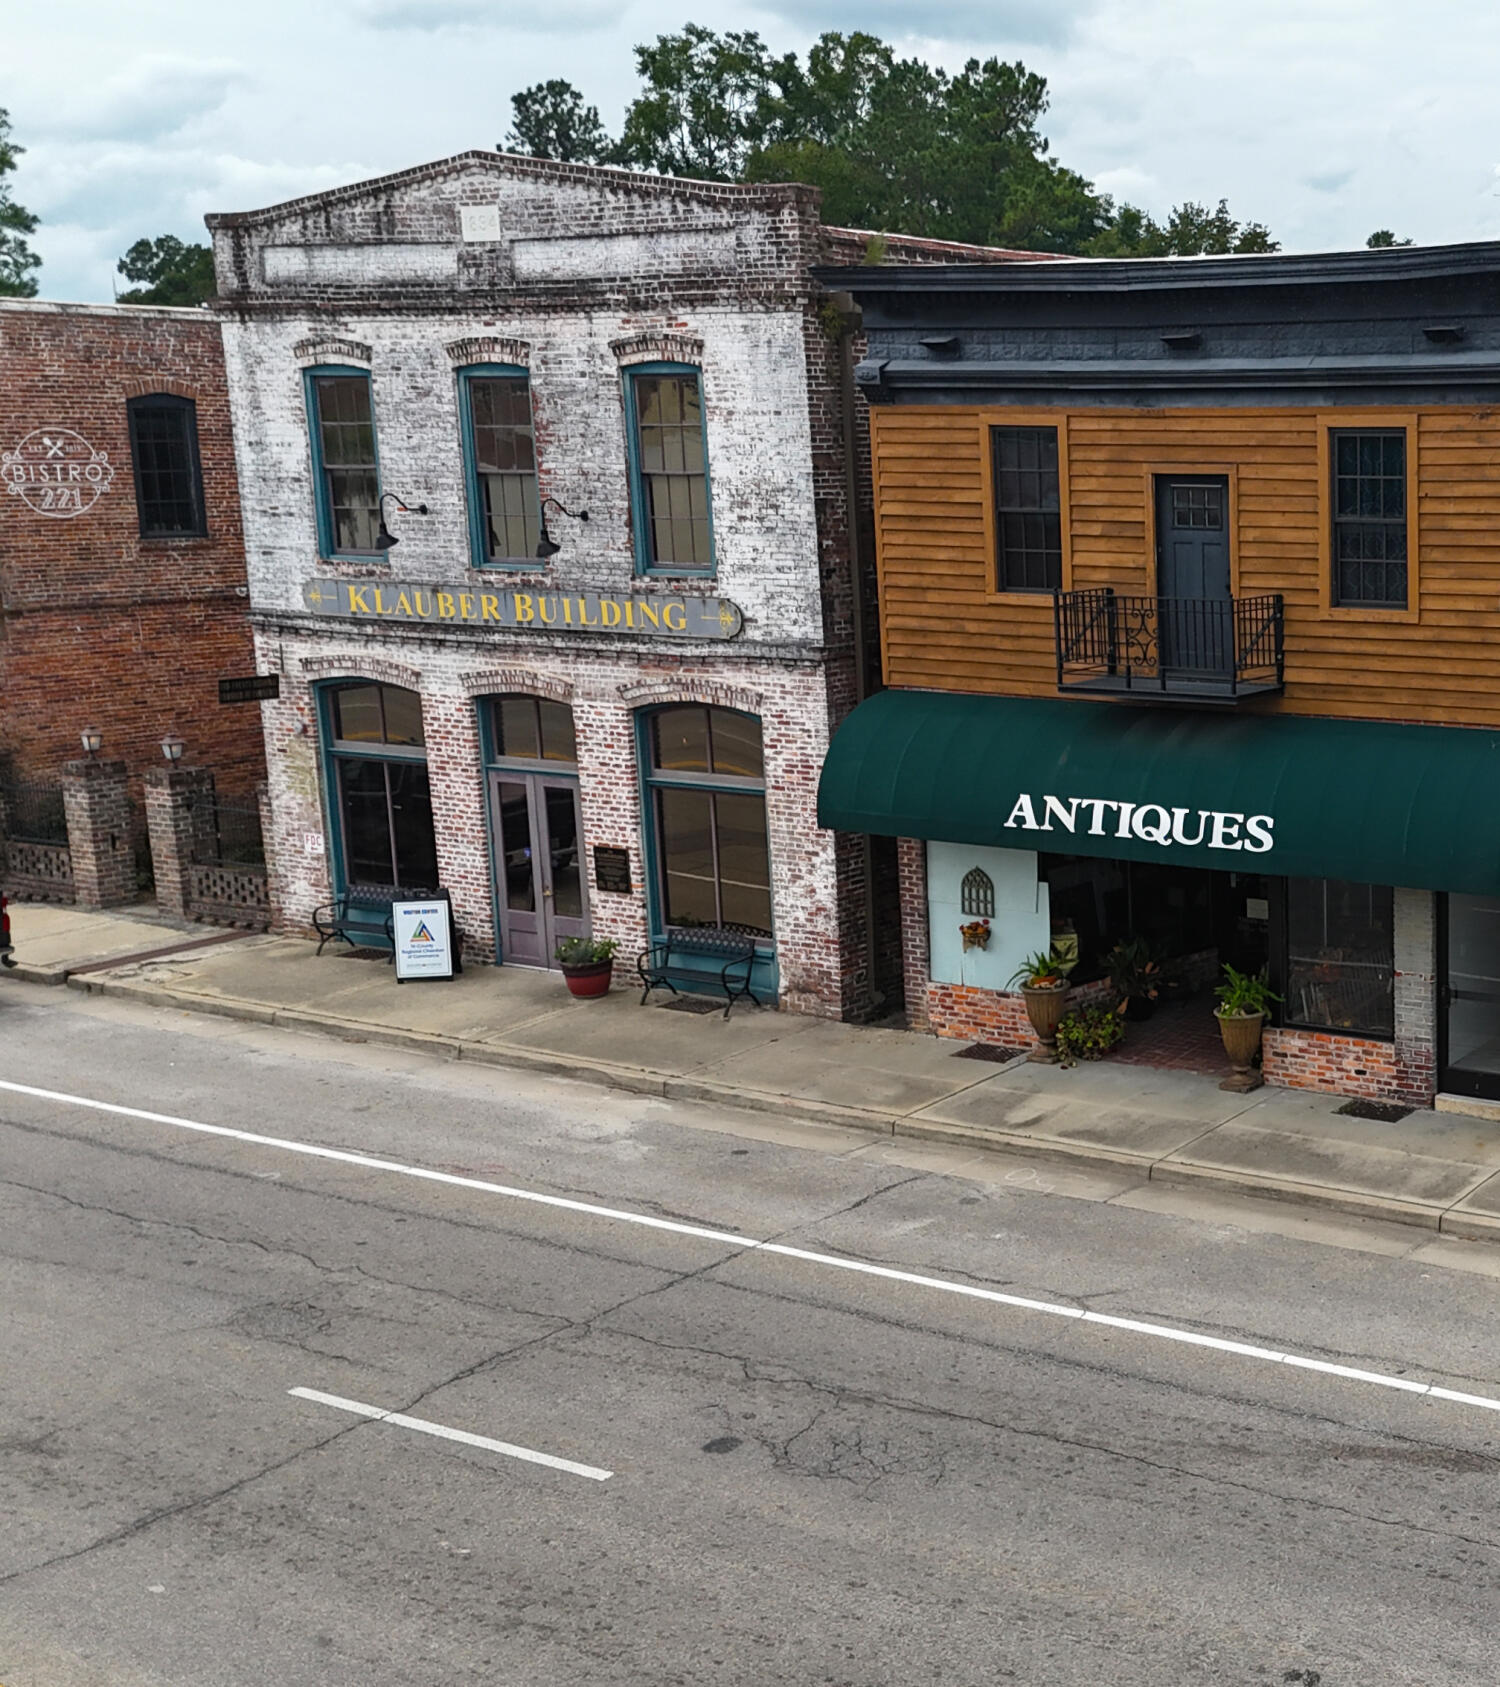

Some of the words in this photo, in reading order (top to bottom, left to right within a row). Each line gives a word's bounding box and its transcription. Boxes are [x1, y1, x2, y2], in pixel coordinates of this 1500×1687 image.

[13, 464, 102, 482] BISTRO
[40, 488, 82, 509] 221
[348, 585, 502, 620] KLAUBER
[513, 593, 687, 630] BUILDING
[1003, 793, 1275, 852] ANTIQUES
[305, 834, 322, 847] FDC
